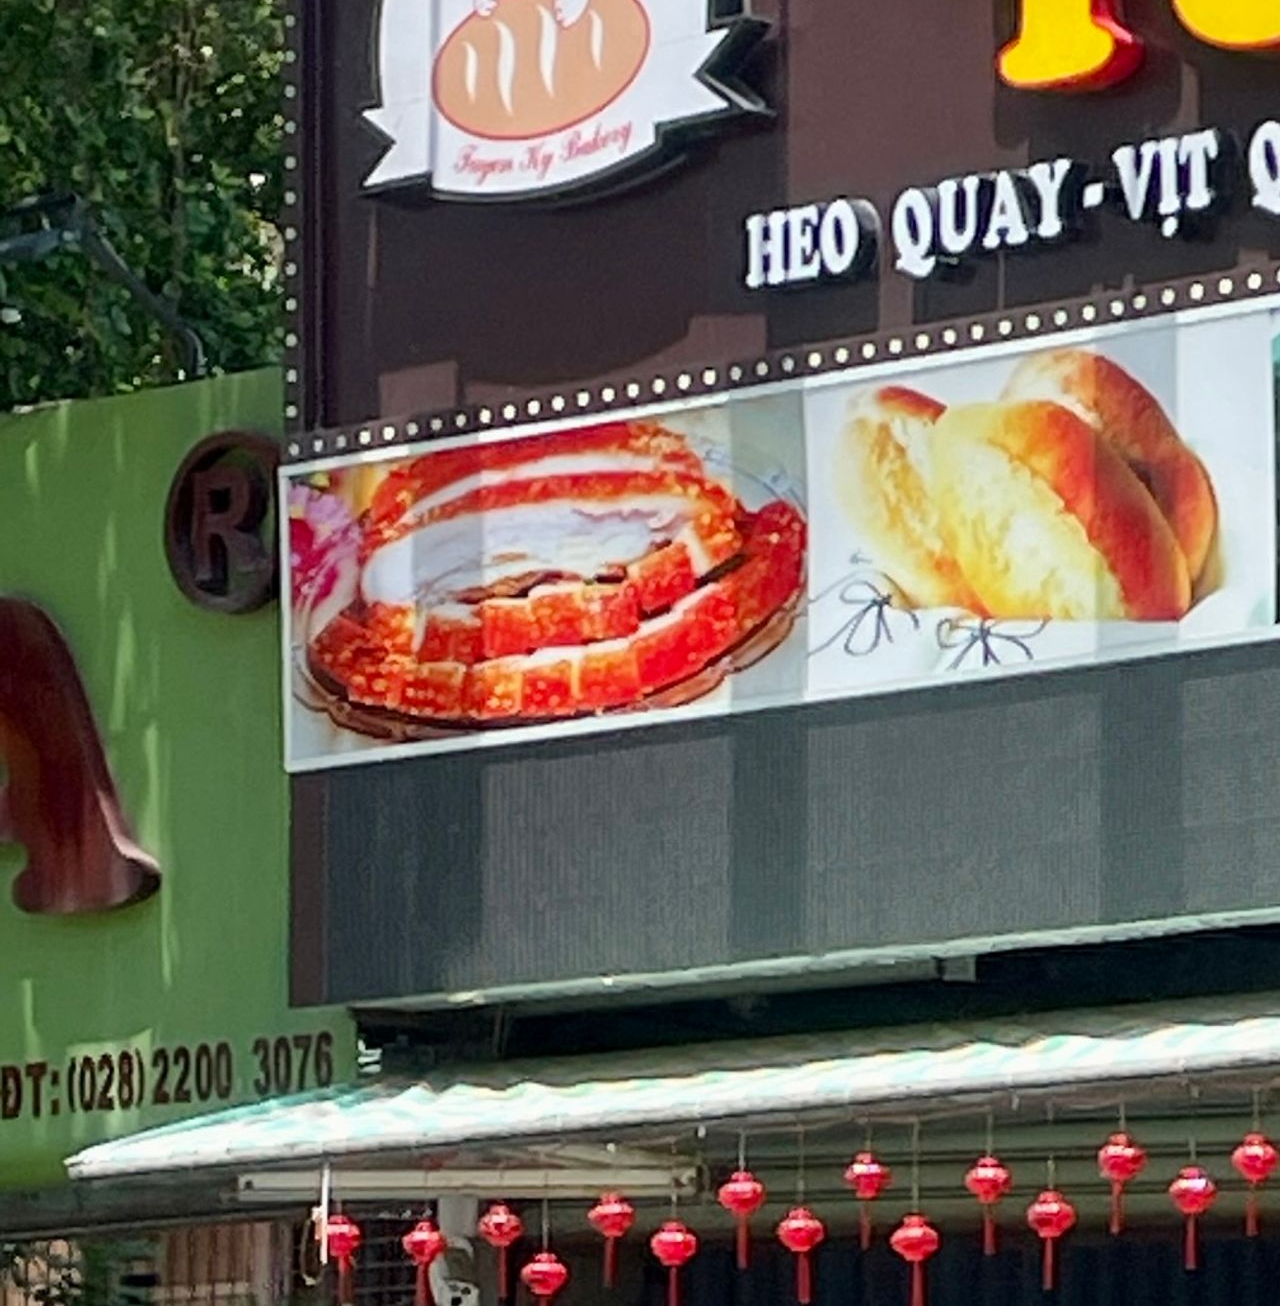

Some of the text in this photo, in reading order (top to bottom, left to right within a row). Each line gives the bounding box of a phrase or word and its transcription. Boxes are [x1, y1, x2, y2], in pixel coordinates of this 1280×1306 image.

[746, 199, 864, 290] HEO
[893, 157, 1075, 278] QUAY
[1110, 130, 1220, 238] VỊT
[253, 1031, 334, 1094] 3076
